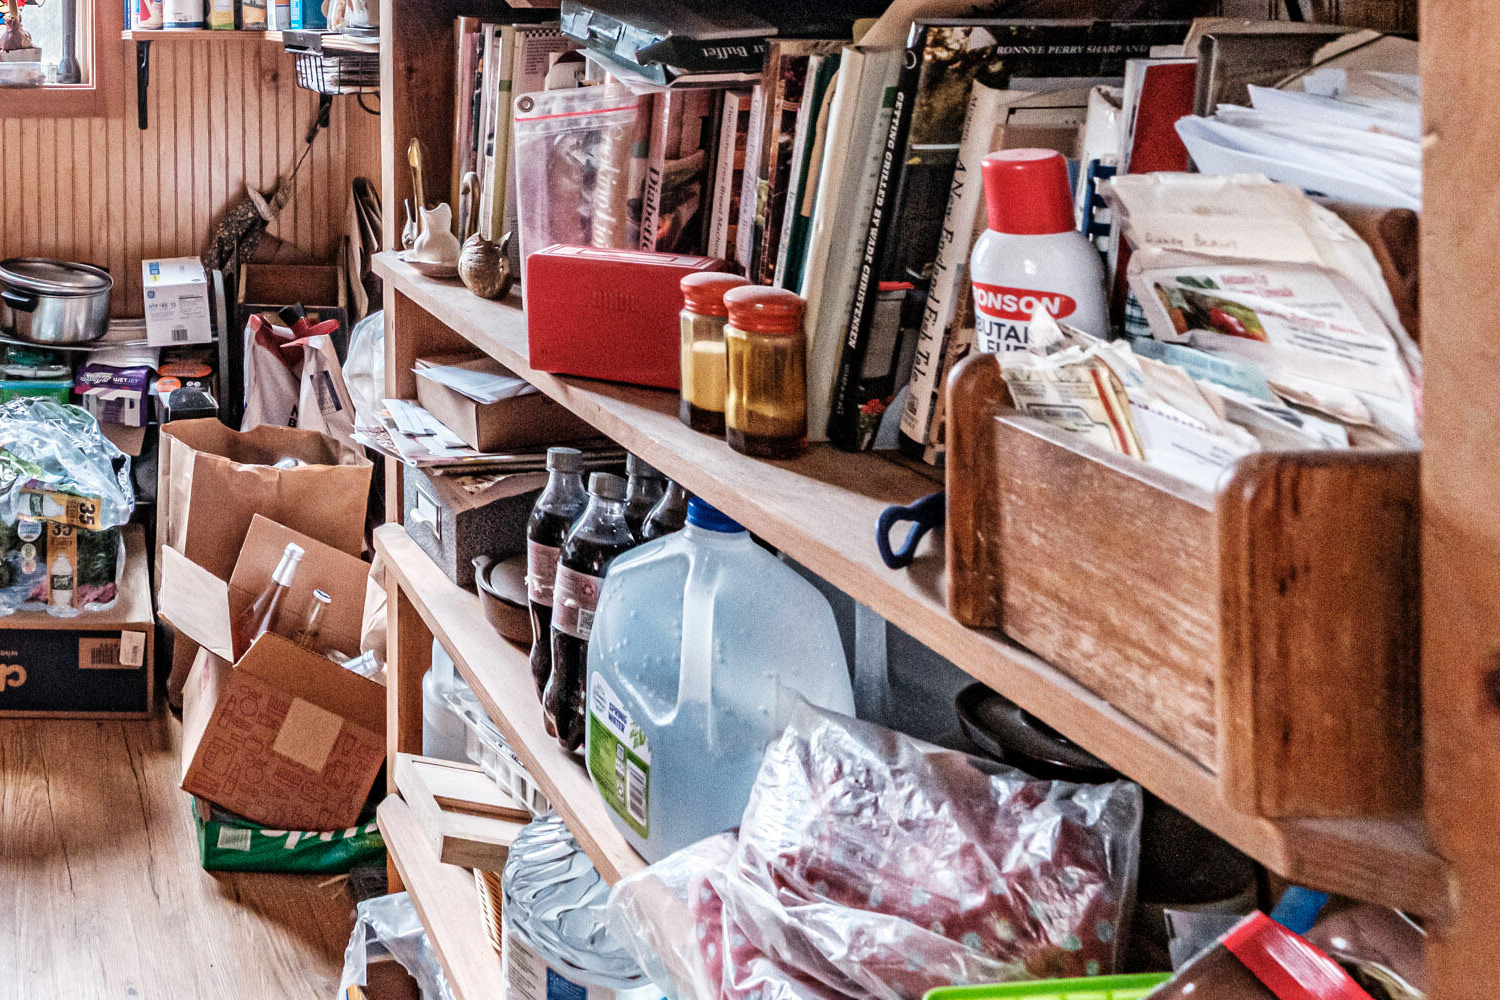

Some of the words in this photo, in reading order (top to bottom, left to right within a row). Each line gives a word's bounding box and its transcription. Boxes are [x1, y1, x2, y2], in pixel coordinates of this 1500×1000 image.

[702, 45, 749, 60] Buffet
[1048, 44, 1084, 54] PERRY
[1087, 44, 1121, 54] SHARP
[887, 91, 905, 150] GETTING
[876, 151, 893, 207] GRILLED
[956, 159, 967, 173] A
[642, 166, 660, 250] Diabetic
[871, 207, 882, 228] BY
[862, 227, 879, 264] WADE
[848, 263, 871, 350] CHRISTENSEN
[919, 305, 939, 342] Fish
[912, 349, 931, 383] Tale
[78, 502, 97, 527] 35
[607, 701, 629, 724] SPRING
[607, 712, 627, 734] WATER
